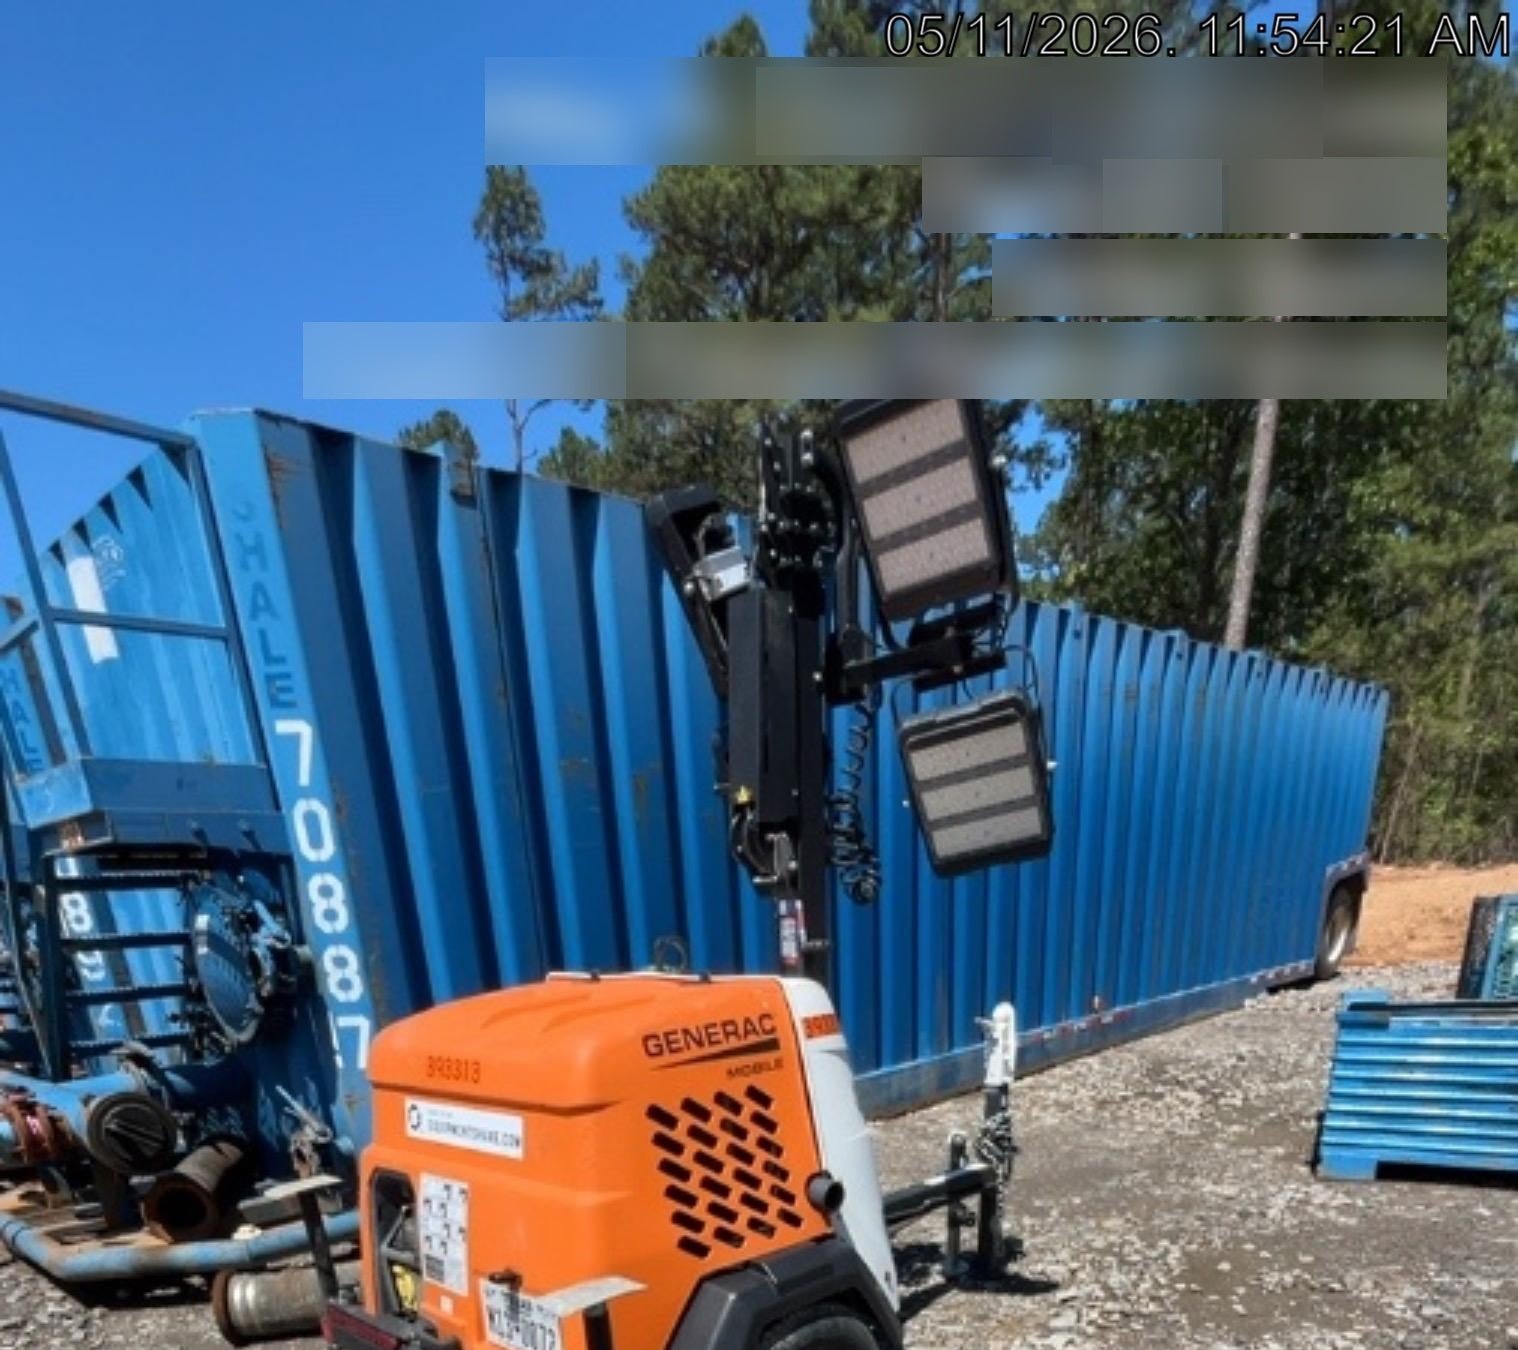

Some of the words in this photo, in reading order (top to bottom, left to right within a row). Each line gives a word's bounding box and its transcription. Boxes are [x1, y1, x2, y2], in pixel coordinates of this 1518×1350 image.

[274, 719, 370, 1070] 70887
[641, 1012, 777, 1057] GENERAC
[726, 1057, 785, 1078] MOBILE
